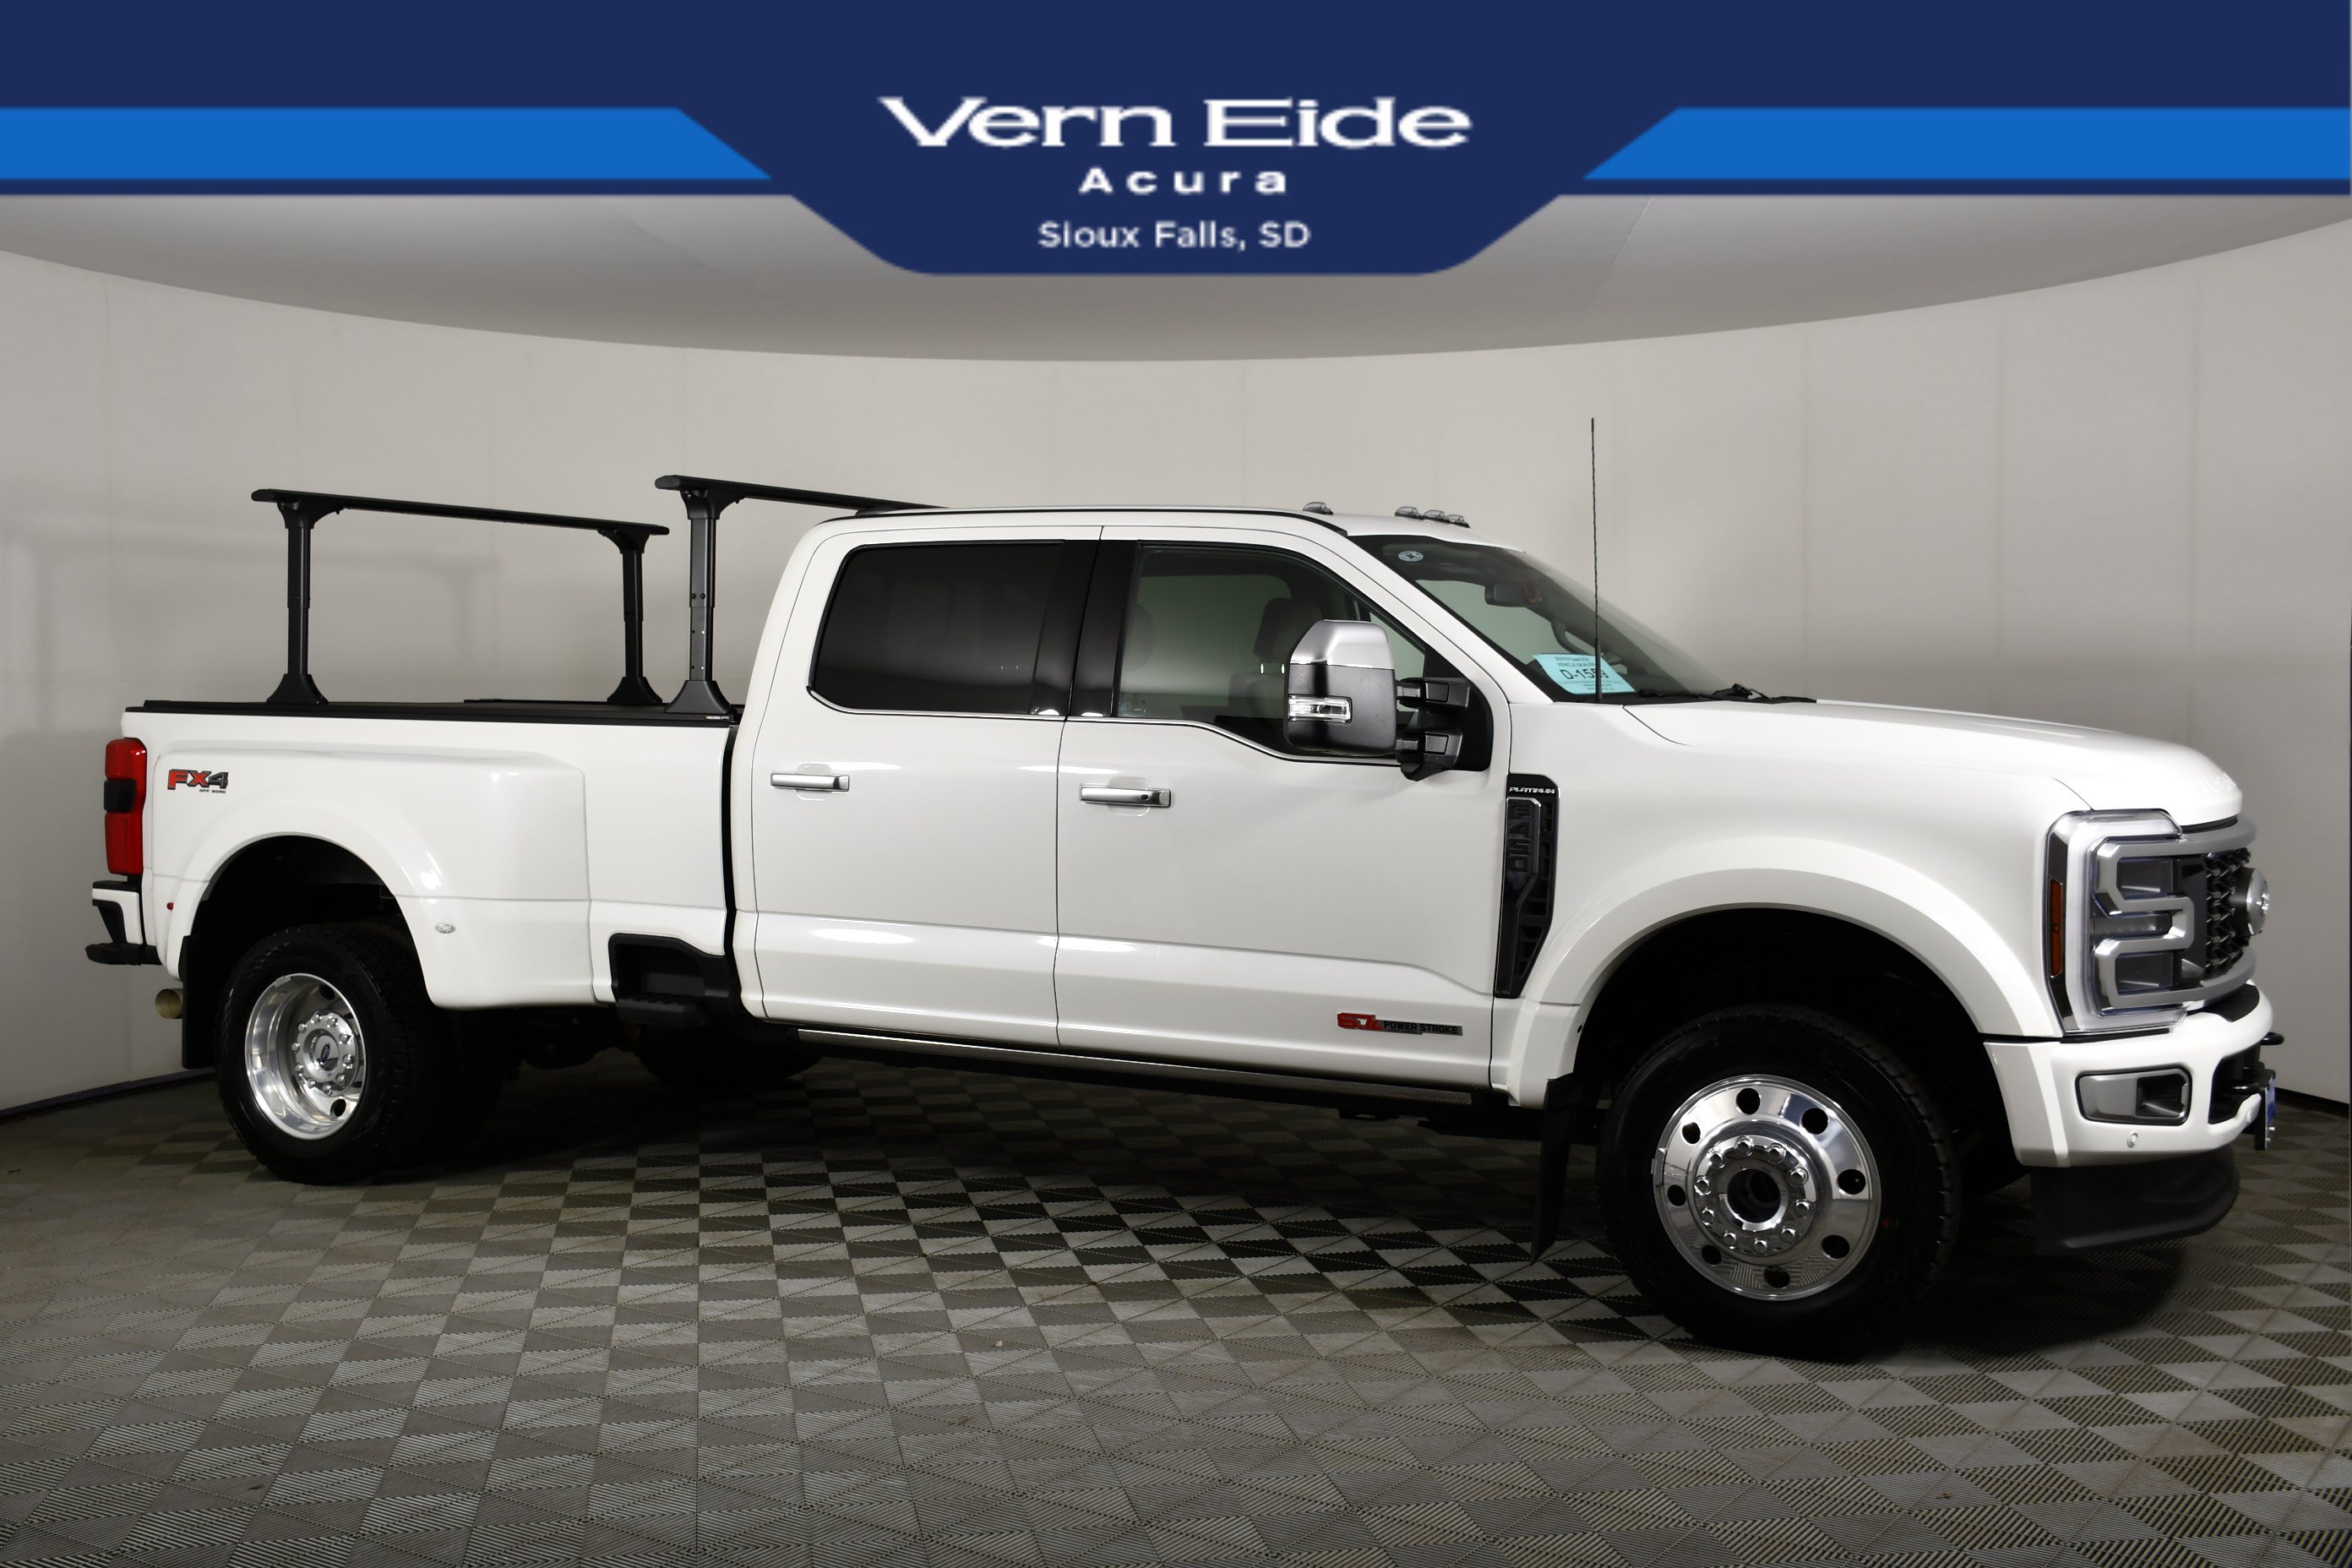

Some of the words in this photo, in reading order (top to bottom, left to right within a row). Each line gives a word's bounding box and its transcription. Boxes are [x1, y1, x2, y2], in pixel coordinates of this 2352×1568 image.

[168, 769, 228, 789] FX4
[1384, 1021, 1418, 1031] POWER
[1420, 1024, 1458, 1034] STROKE
